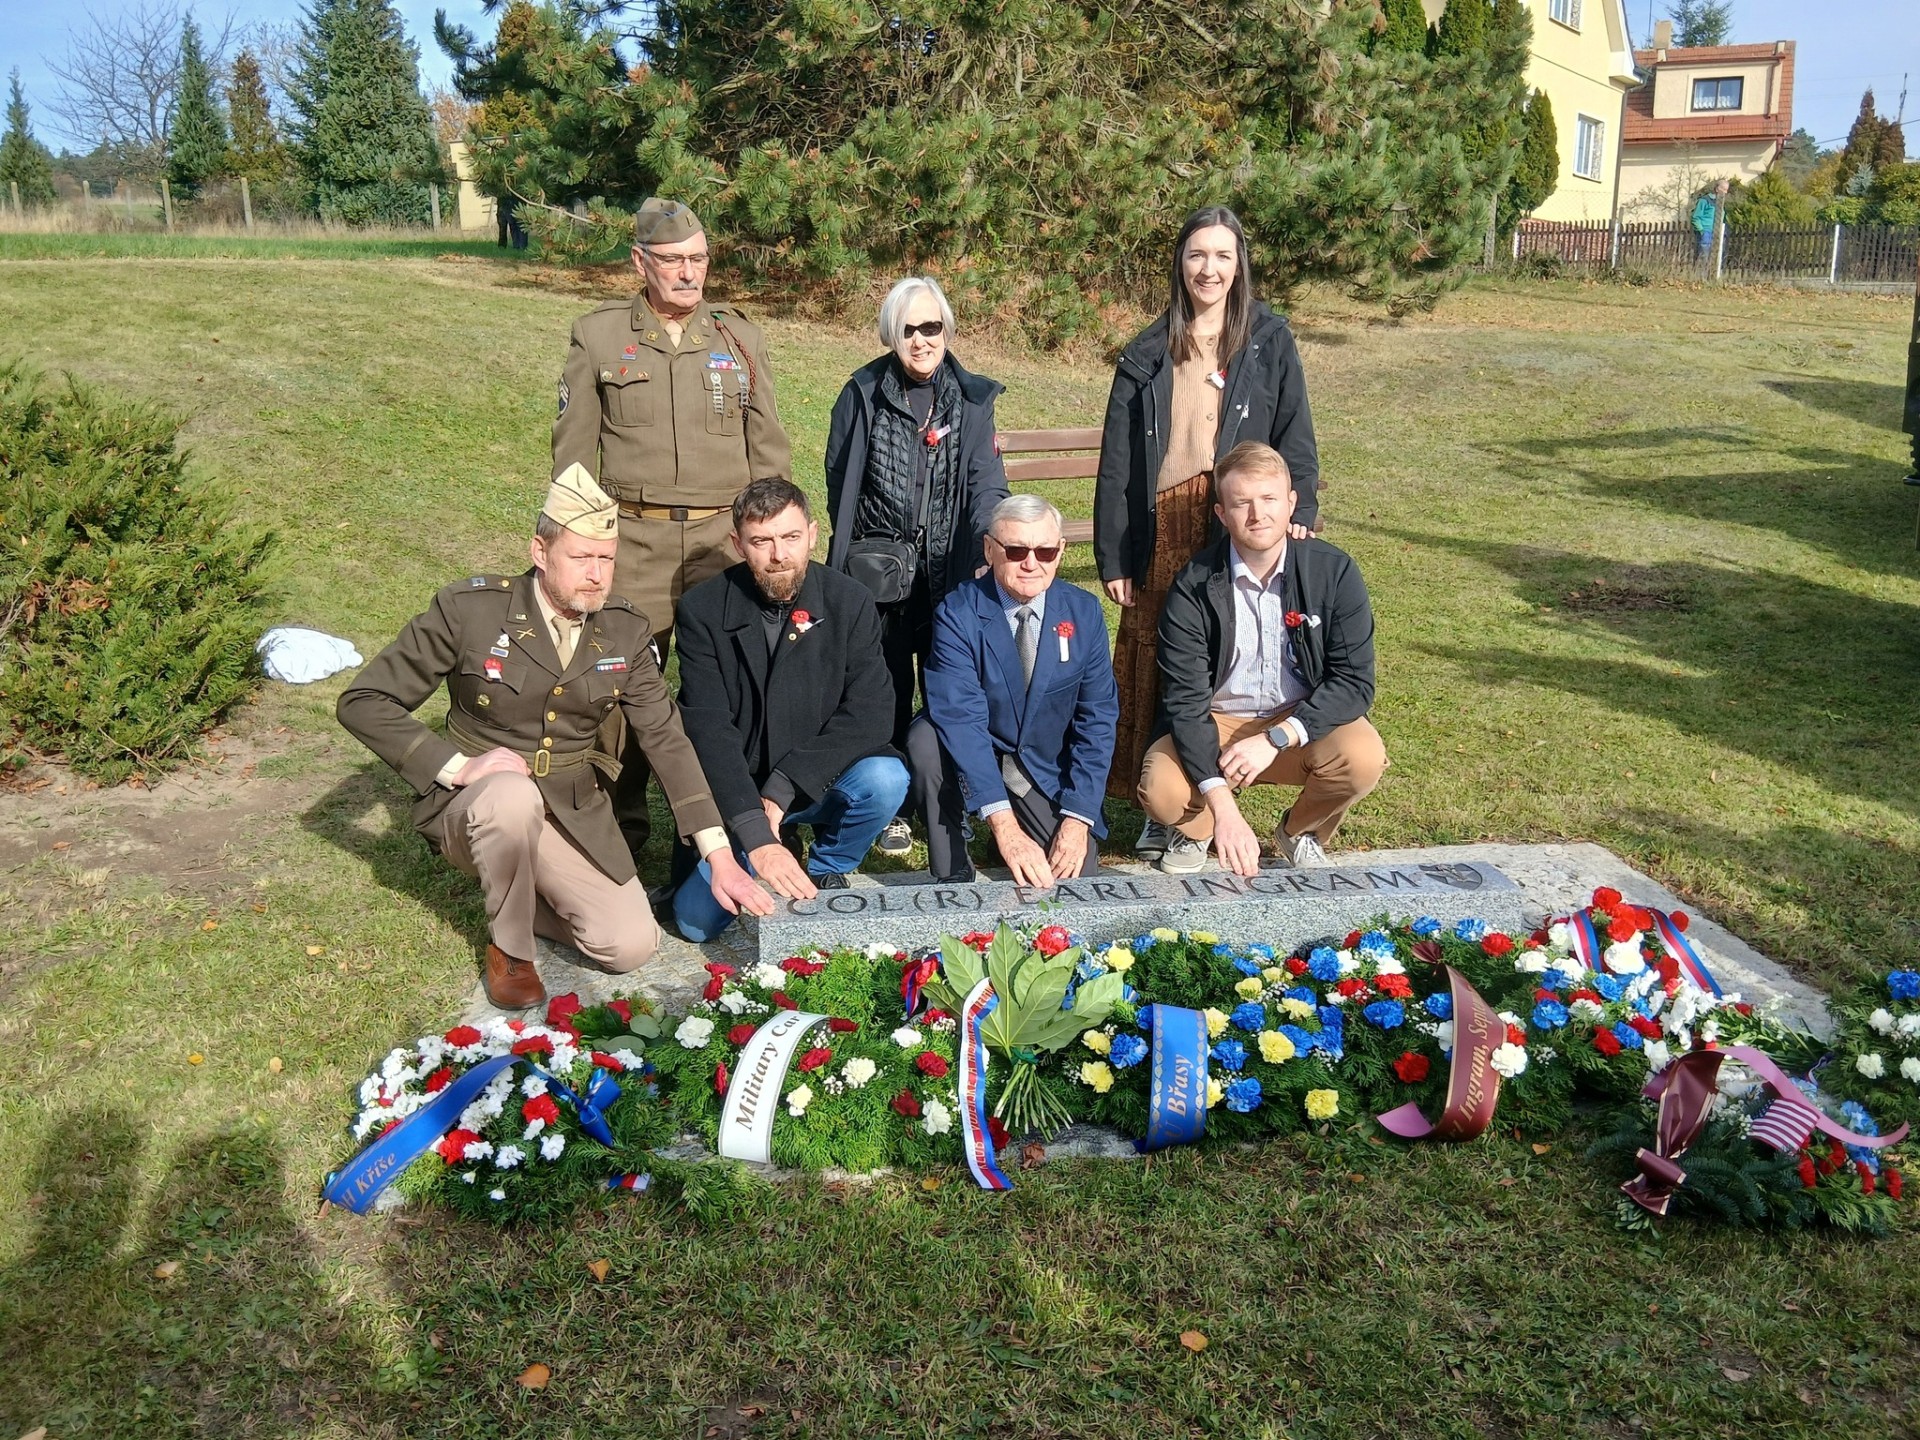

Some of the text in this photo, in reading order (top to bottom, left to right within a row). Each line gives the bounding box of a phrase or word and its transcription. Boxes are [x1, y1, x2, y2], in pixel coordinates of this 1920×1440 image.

[786, 870, 1421, 916] COL(R) EARL INGRAM
[735, 1015, 800, 1132] Military Car
[1167, 1054, 1194, 1118] Břasy
[1457, 1043, 1490, 1122] Ingram,
